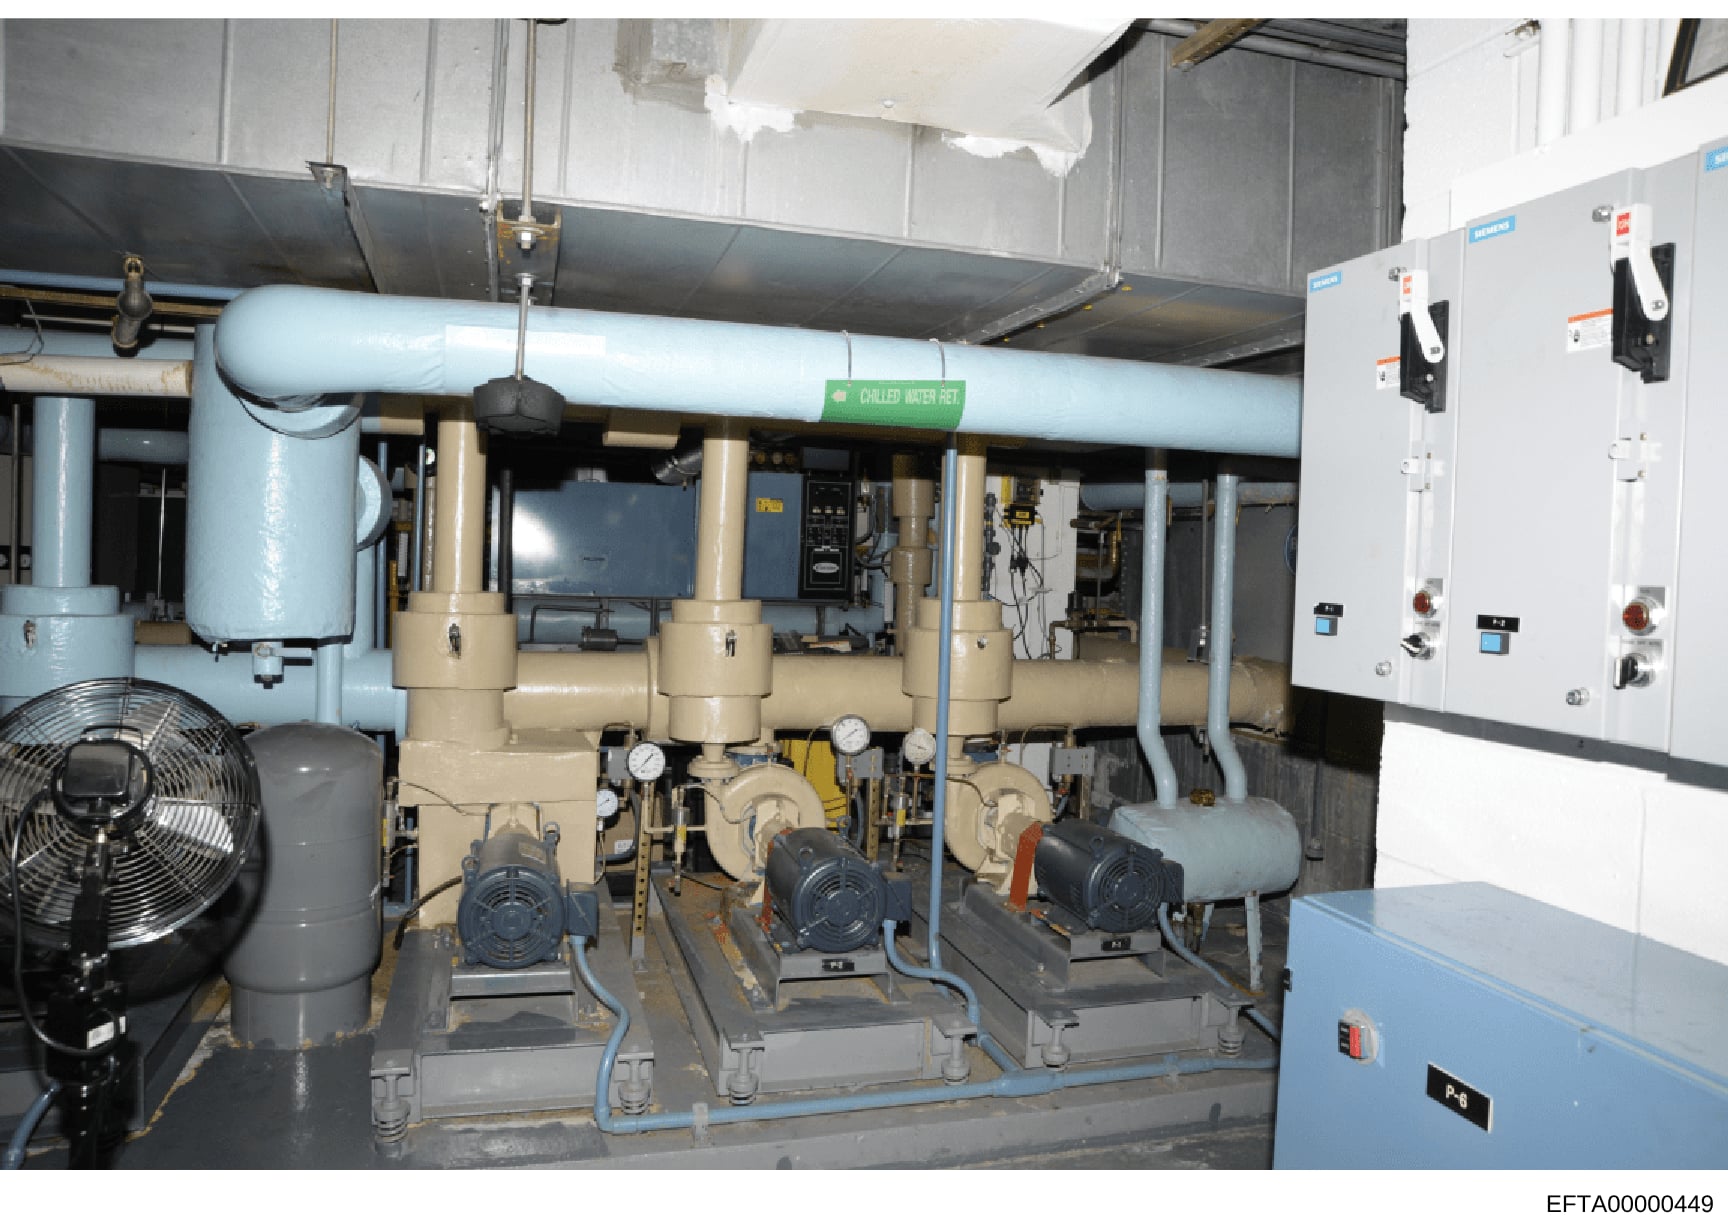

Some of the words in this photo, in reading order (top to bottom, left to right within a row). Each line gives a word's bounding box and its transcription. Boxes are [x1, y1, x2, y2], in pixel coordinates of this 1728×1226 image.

[1474, 221, 1510, 240] SIEMENS
[1312, 276, 1338, 289] SIEMENS
[860, 388, 900, 405] CHILLED
[904, 388, 936, 405] WATER
[938, 388, 961, 405] RET.
[1445, 1083, 1468, 1110] P-6
